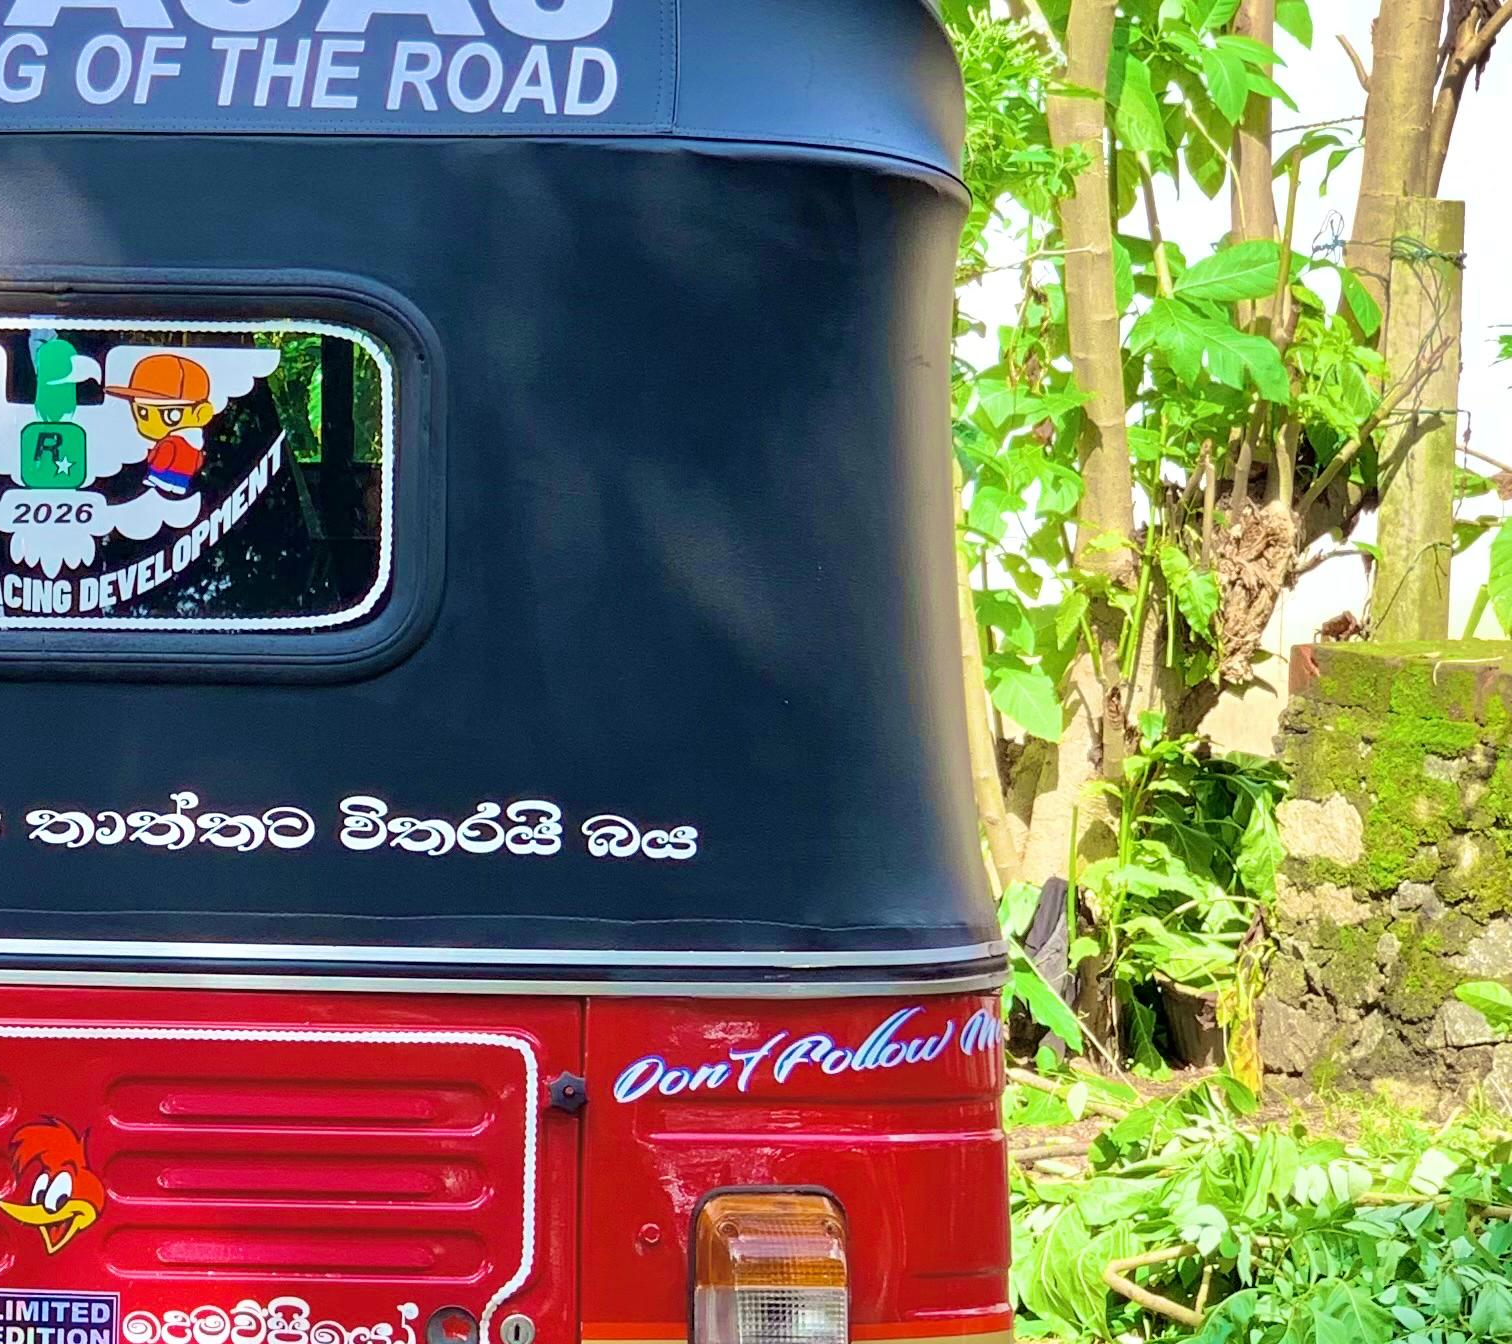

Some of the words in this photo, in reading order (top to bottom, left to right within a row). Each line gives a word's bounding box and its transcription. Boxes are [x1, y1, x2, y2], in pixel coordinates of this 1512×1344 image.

[74, 31, 185, 105] OF
[210, 33, 365, 109] THE
[386, 39, 618, 116] ROAD
[12, 503, 94, 525] 2026
[79, 428, 287, 613] DEVELOPMENT
[26, 791, 315, 851] තාත්තට
[339, 795, 562, 856] විතරයි
[581, 815, 699, 860] බය
